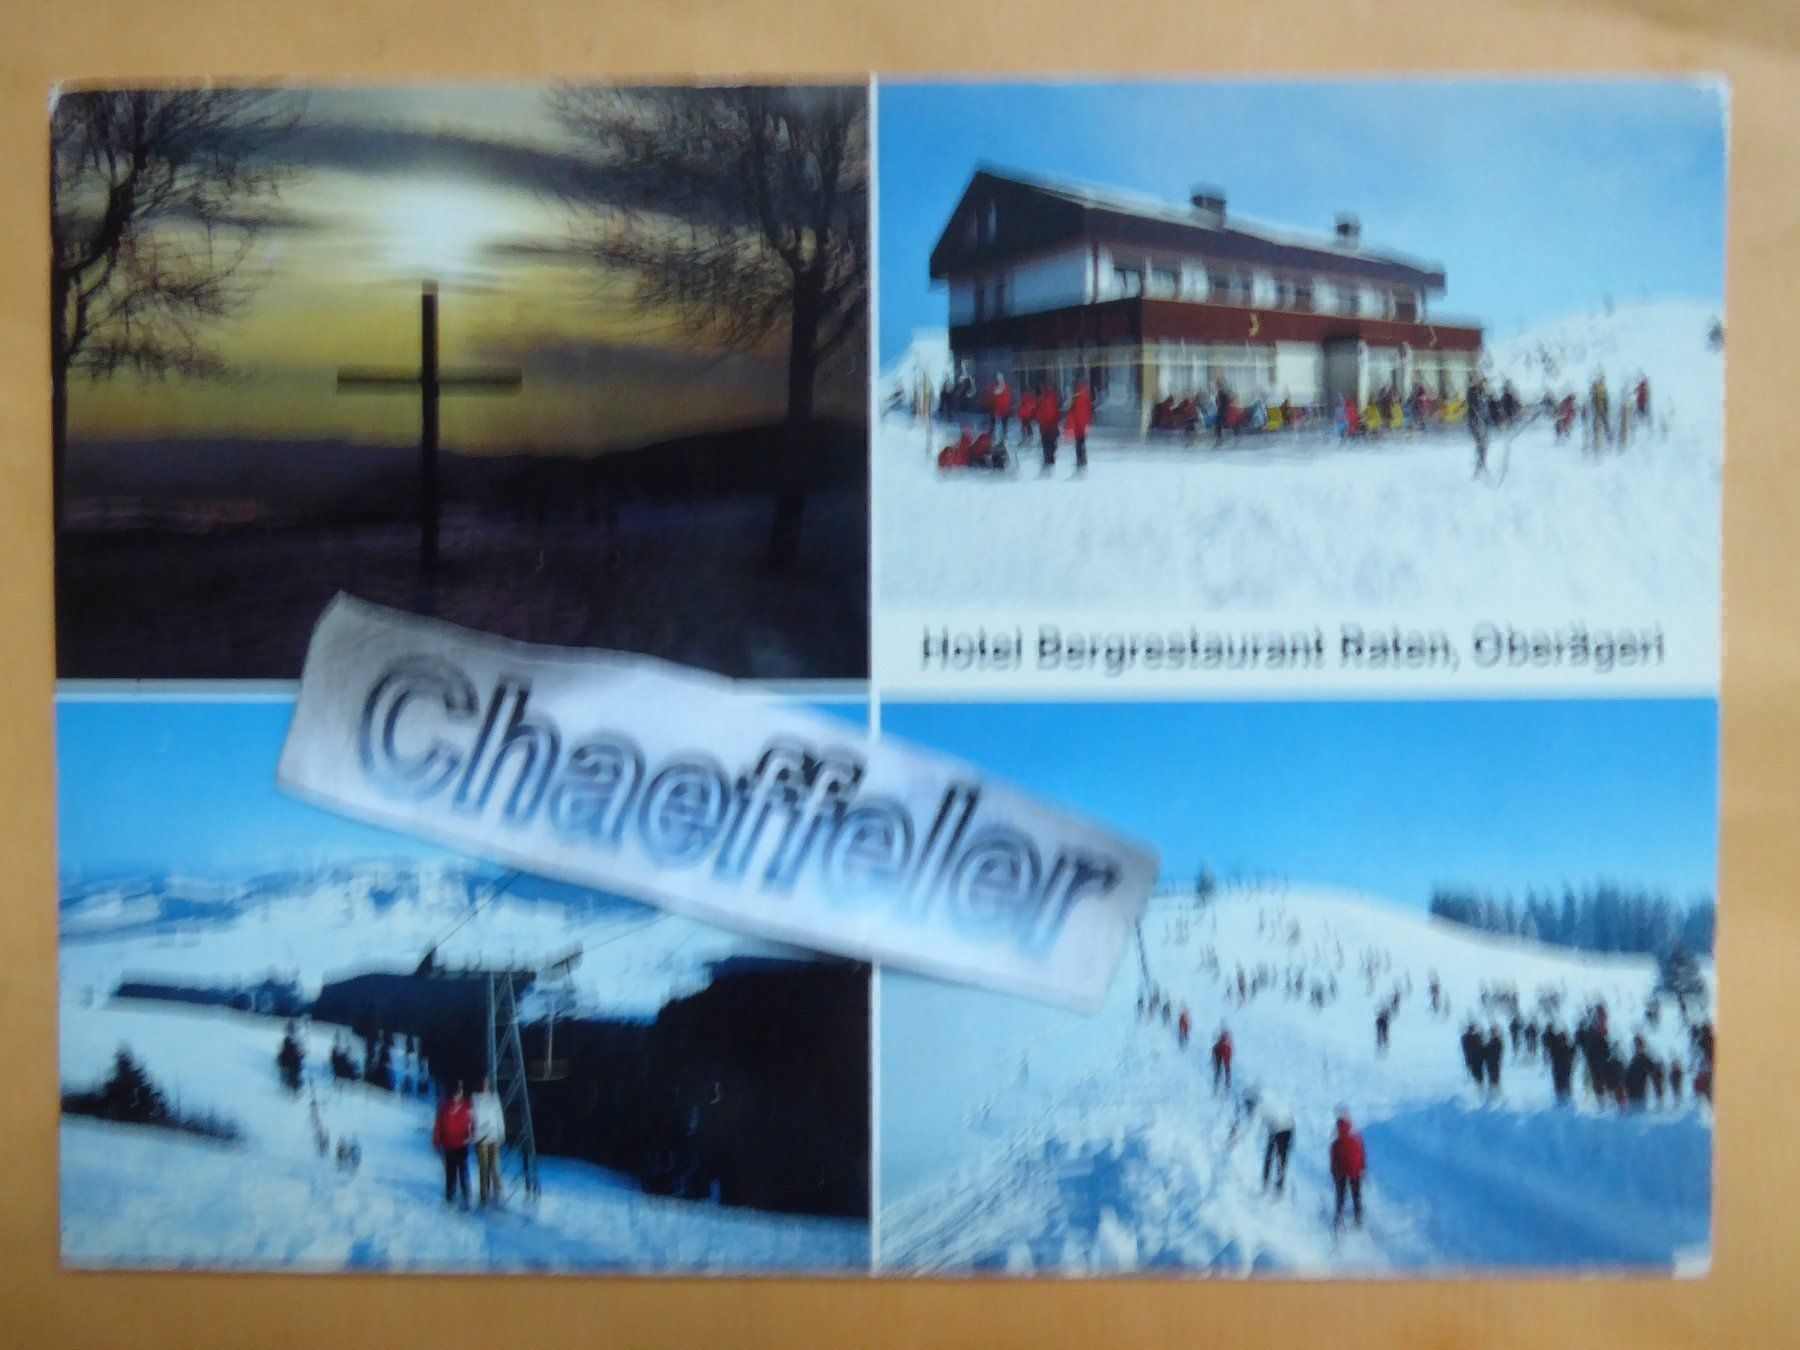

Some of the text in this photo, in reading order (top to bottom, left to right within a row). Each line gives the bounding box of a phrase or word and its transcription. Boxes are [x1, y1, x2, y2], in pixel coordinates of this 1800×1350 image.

[920, 619, 1665, 678] Hotel Bergrestaurant Raten, Oberägeri
[359, 653, 1122, 960] Chaeffeler
